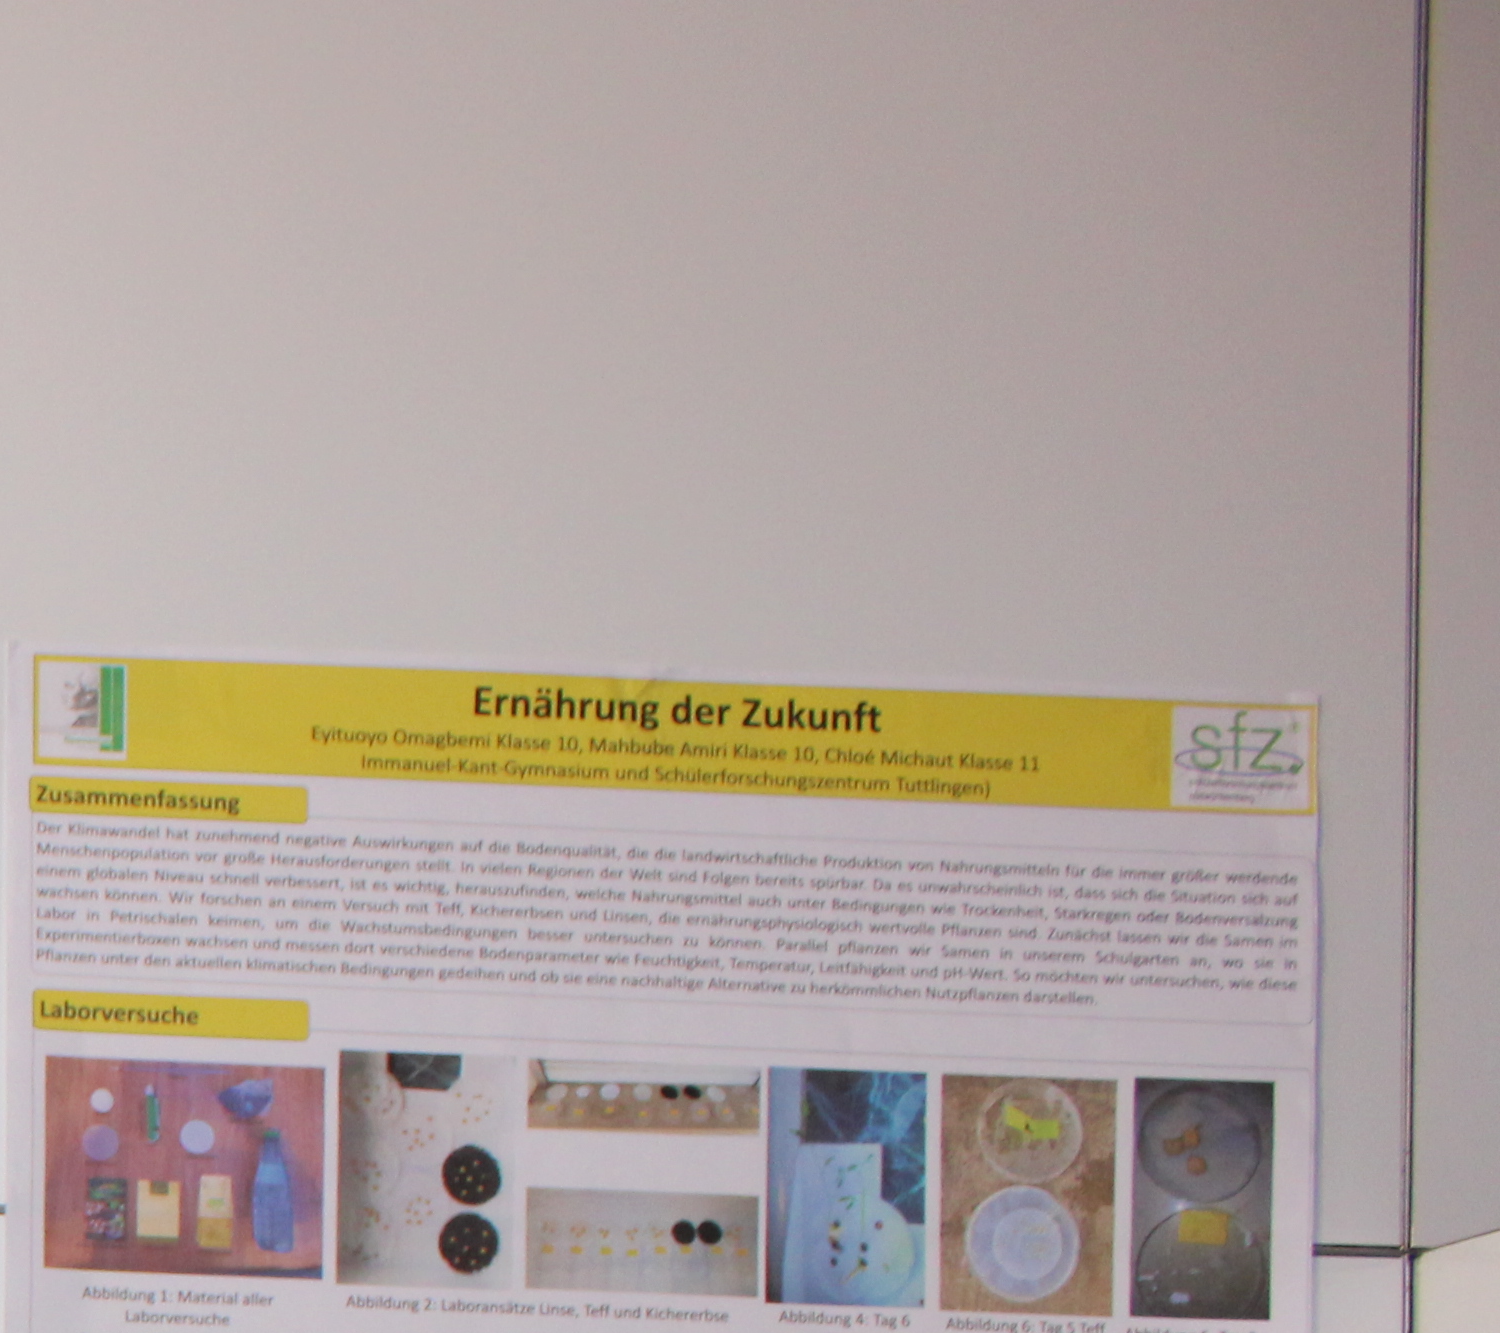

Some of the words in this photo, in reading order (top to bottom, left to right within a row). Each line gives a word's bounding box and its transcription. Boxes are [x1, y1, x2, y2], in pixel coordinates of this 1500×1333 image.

[474, 686, 659, 731] Ernährung
[671, 694, 730, 726] der
[742, 699, 880, 733] Zukunft
[311, 725, 387, 748] Eyituoyo
[392, 729, 490, 750] Omagbemi
[496, 733, 551, 751] Klasse
[558, 736, 583, 756] 10,
[588, 736, 674, 757] Mahbube
[680, 742, 727, 758] Amiri
[732, 743, 787, 761] Klasse
[794, 745, 819, 765] 10,
[824, 746, 875, 765] Chloé
[880, 750, 953, 768] Michaut
[959, 753, 1013, 771] Klasse
[1020, 755, 1039, 773] 11
[361, 754, 609, 780] Immanuel-Kant-Gymnasium
[615, 765, 649, 781] und
[655, 765, 890, 792] Schülerforschungszentrum
[896, 775, 990, 800] Tuttlingen)
[34, 784, 239, 817] Zusammenfassung
[39, 999, 198, 1026] Laborversuche
